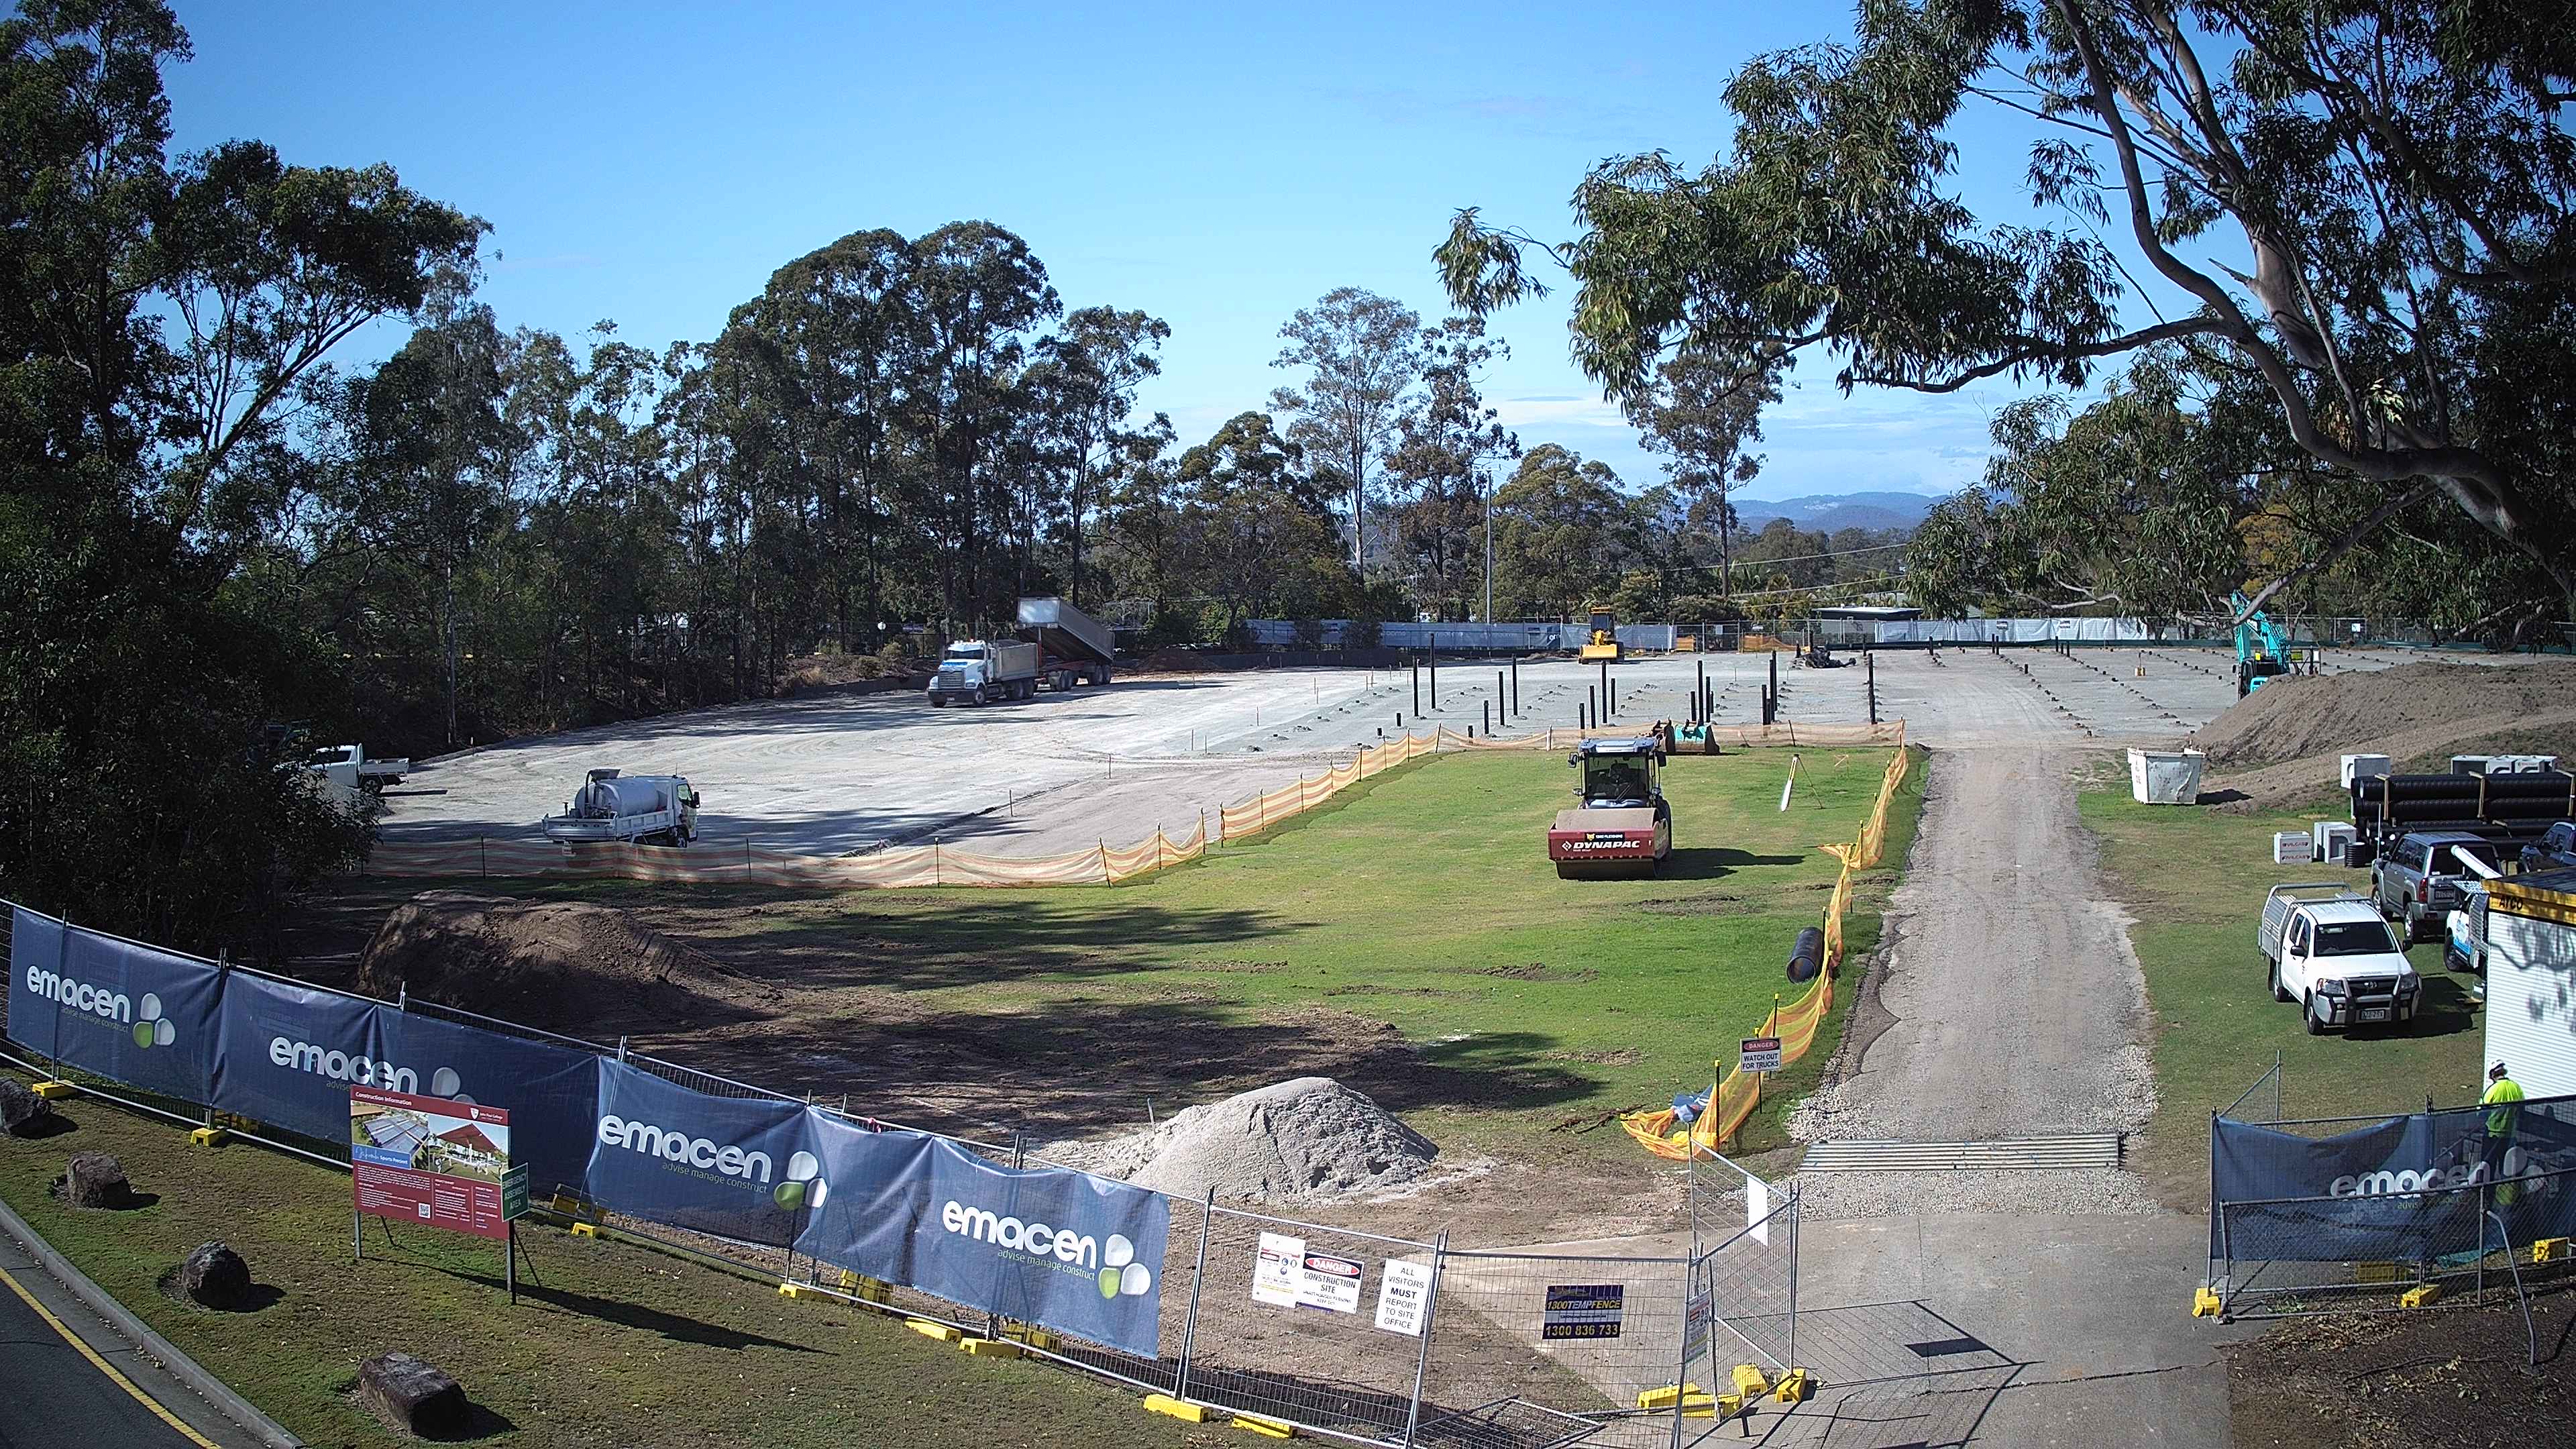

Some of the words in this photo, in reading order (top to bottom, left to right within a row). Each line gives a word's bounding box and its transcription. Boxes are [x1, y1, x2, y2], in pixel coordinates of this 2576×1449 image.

[1573, 841, 1640, 849] DYNAPAC
[2499, 895, 2524, 911] ATCO
[27, 965, 131, 1023] emacen
[1743, 1054, 1765, 1062] WATCH
[1756, 1060, 1779, 1069] TRUCKS
[270, 1036, 418, 1095] emacen
[356, 1091, 384, 1102] Construction
[384, 1097, 412, 1106] Information
[598, 1114, 771, 1183] emacen
[662, 1161, 690, 1175] advise
[691, 1169, 725, 1185] manage
[727, 1178, 768, 1193] construct
[2330, 1161, 2491, 1201] emacen
[504, 1185, 526, 1201] ASSEMBLY
[510, 1198, 521, 1210] AREA
[2397, 1200, 2420, 1210] advis
[943, 1200, 1097, 1270] emacen
[998, 1249, 1025, 1263] advise
[1027, 1256, 1061, 1271] manage
[1063, 1265, 1095, 1281] construct
[1313, 1258, 1352, 1274] DANGER
[1401, 1267, 1415, 1276] ALL
[1304, 1271, 1356, 1289] CONSTRUCTION
[1389, 1275, 1424, 1288] VISITORS
[1320, 1284, 1336, 1294] SITE
[1390, 1287, 1417, 1299] MUST
[1385, 1297, 1417, 1309] REPORT
[1547, 1300, 1621, 1309] 1300TEMPFENCE
[1385, 1307, 1396, 1315] TO
[1397, 1310, 1415, 1320] SITE
[1384, 1317, 1412, 1329] OFFICE
[1546, 1325, 1572, 1336] 1300
[1575, 1325, 1595, 1336] 836
[1599, 1324, 1618, 1335] 733
